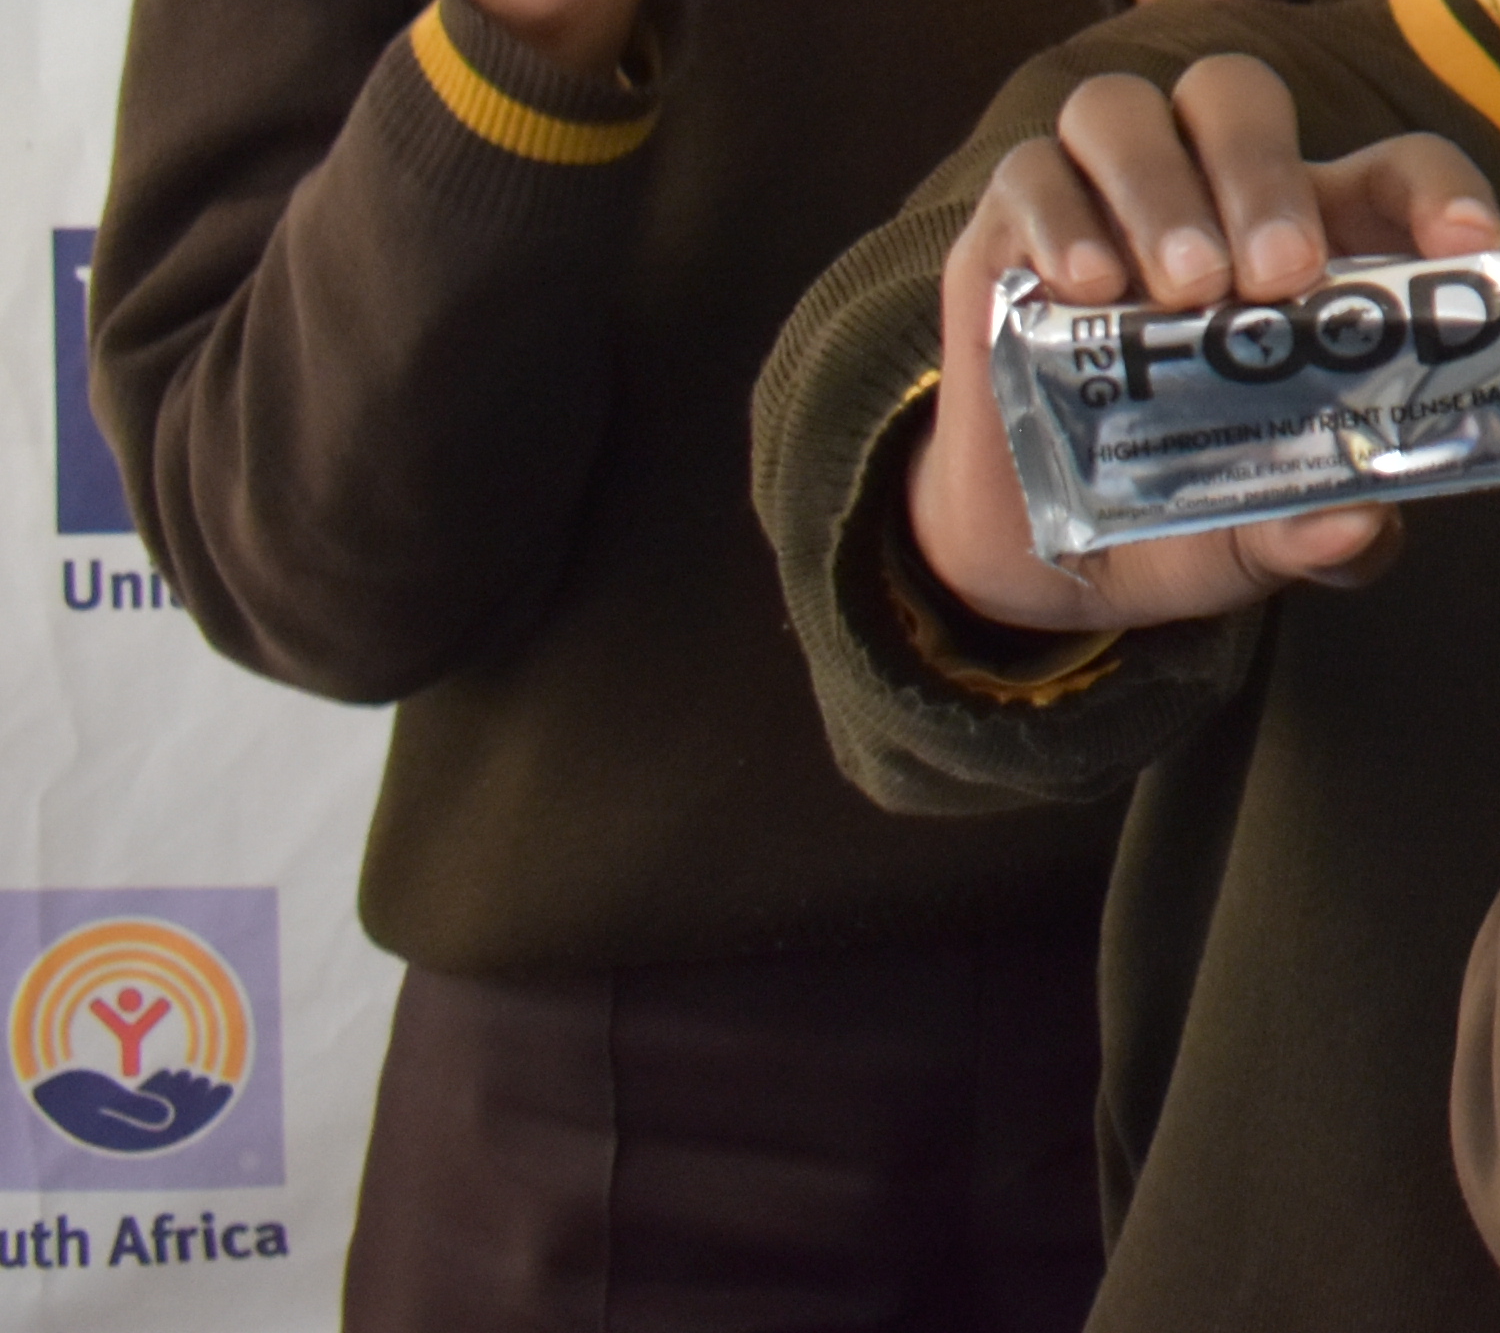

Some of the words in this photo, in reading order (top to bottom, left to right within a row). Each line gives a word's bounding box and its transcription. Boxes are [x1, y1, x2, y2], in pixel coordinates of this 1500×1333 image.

[1071, 312, 1119, 411] E2G
[0, 1214, 90, 1269] uth
[109, 1210, 290, 1267] Africa
